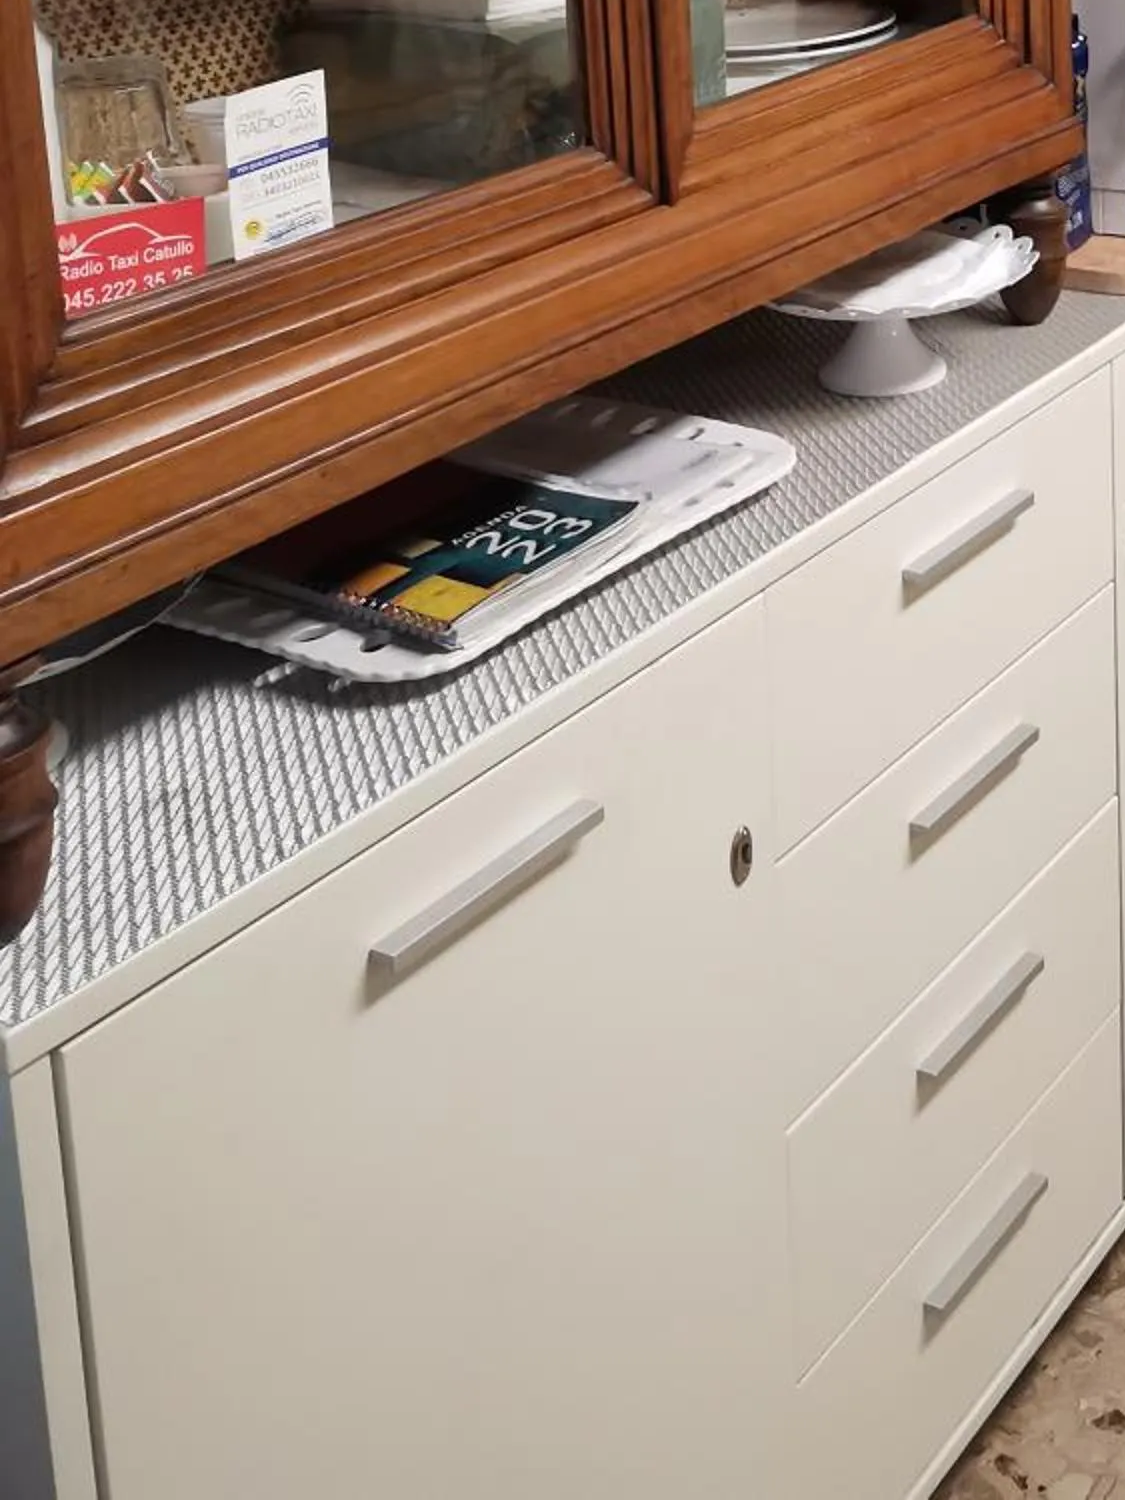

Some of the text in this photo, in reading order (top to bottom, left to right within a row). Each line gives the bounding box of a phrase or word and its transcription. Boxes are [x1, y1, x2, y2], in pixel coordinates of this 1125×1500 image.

[60, 240, 194, 281] Radio Taxi Catullo
[501, 516, 593, 565] 23
